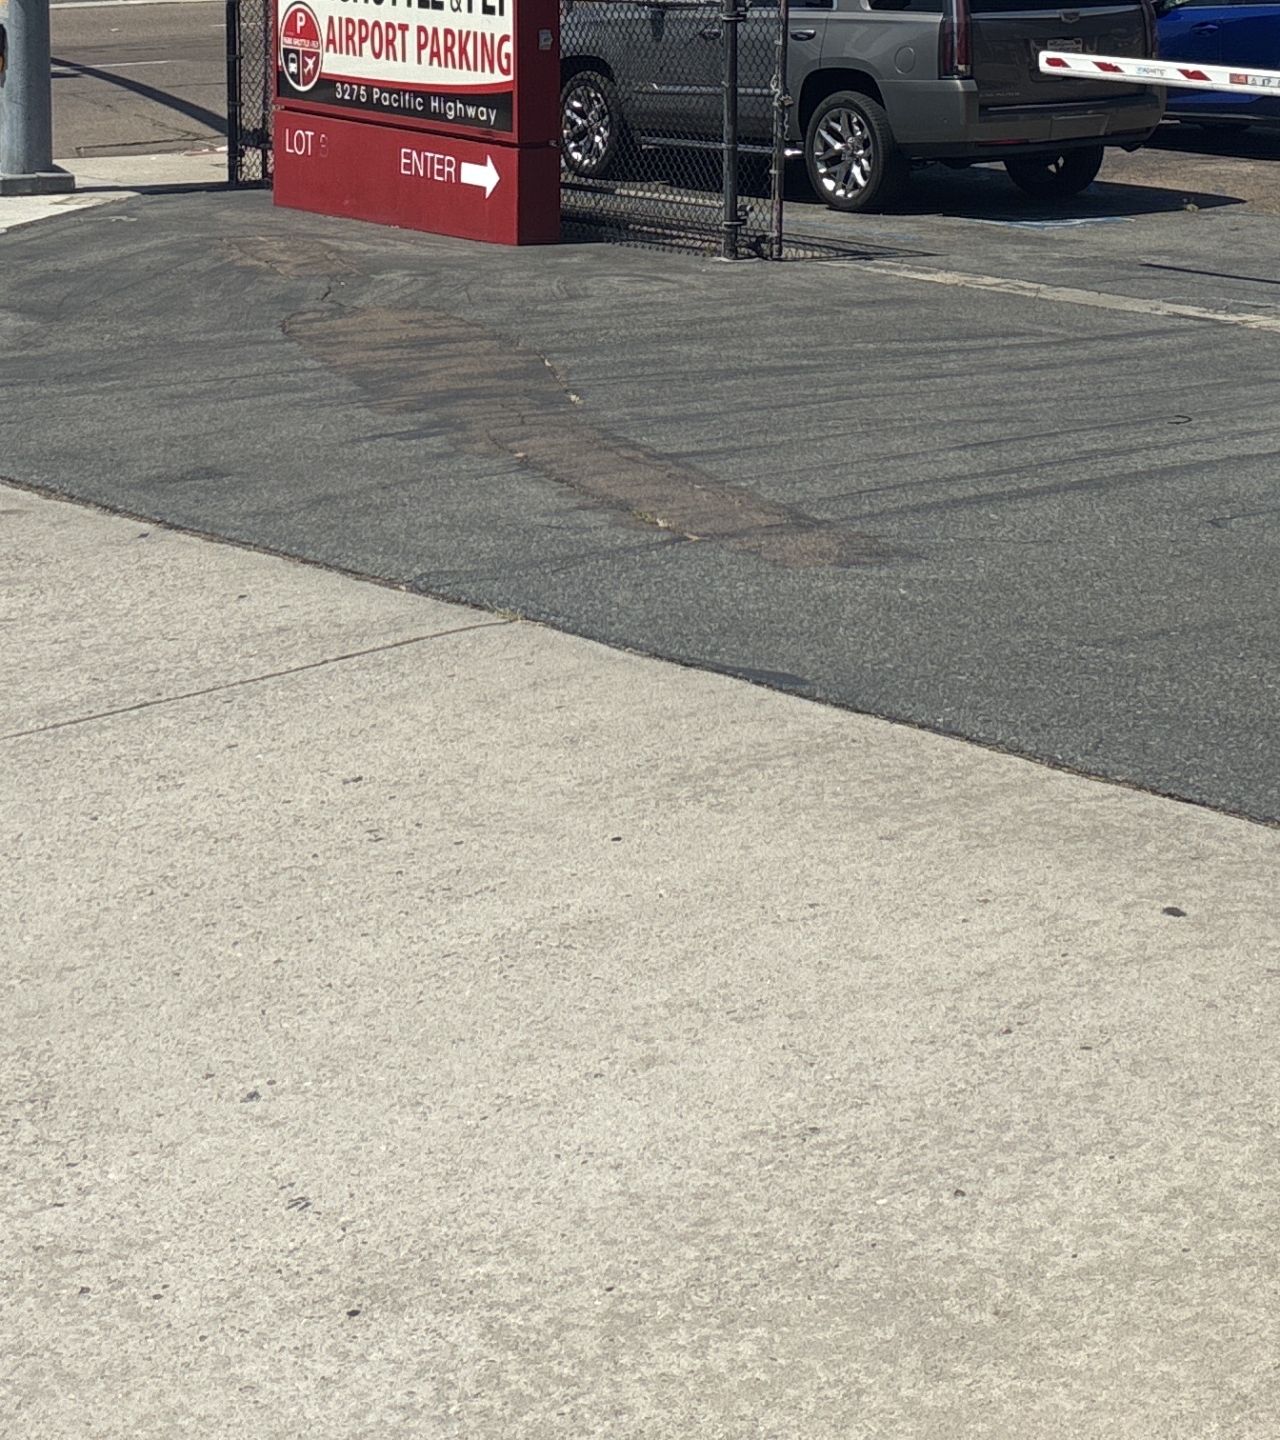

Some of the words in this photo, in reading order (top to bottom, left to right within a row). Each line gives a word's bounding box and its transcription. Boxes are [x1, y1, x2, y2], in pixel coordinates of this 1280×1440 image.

[325, 15, 410, 63] AIRPORT
[417, 25, 511, 76] PARKING
[335, 82, 367, 102] 3275
[372, 88, 424, 111] Pacific
[430, 95, 497, 125] Highway
[285, 128, 314, 156] LOT
[400, 148, 455, 183] ENTER
